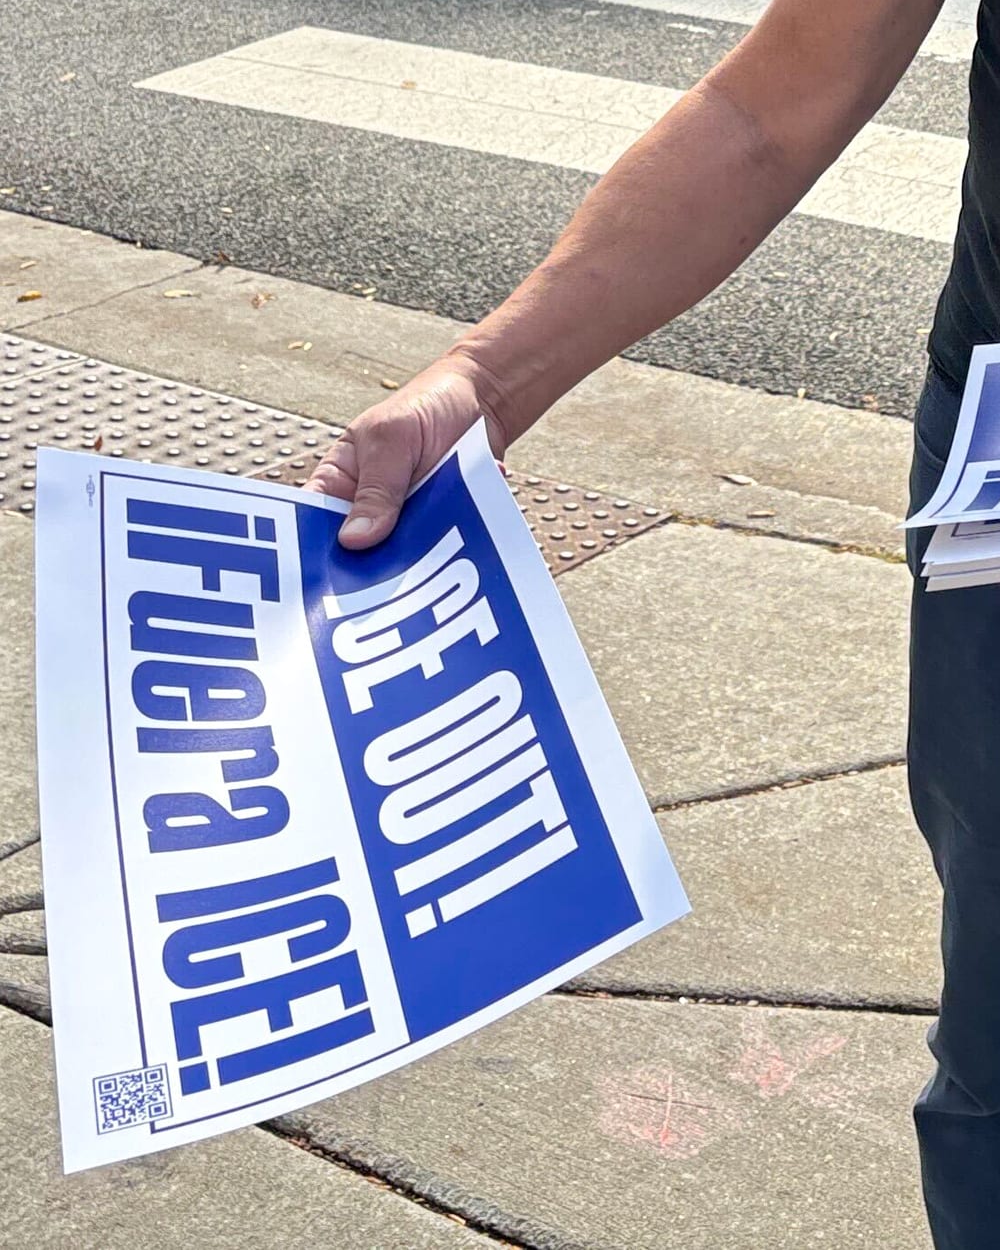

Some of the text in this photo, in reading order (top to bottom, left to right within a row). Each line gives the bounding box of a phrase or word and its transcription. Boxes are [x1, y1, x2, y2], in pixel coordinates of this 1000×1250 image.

[126, 497, 376, 1095] ¡Fuera ICE!
[323, 525, 579, 940] ICE OUT!
